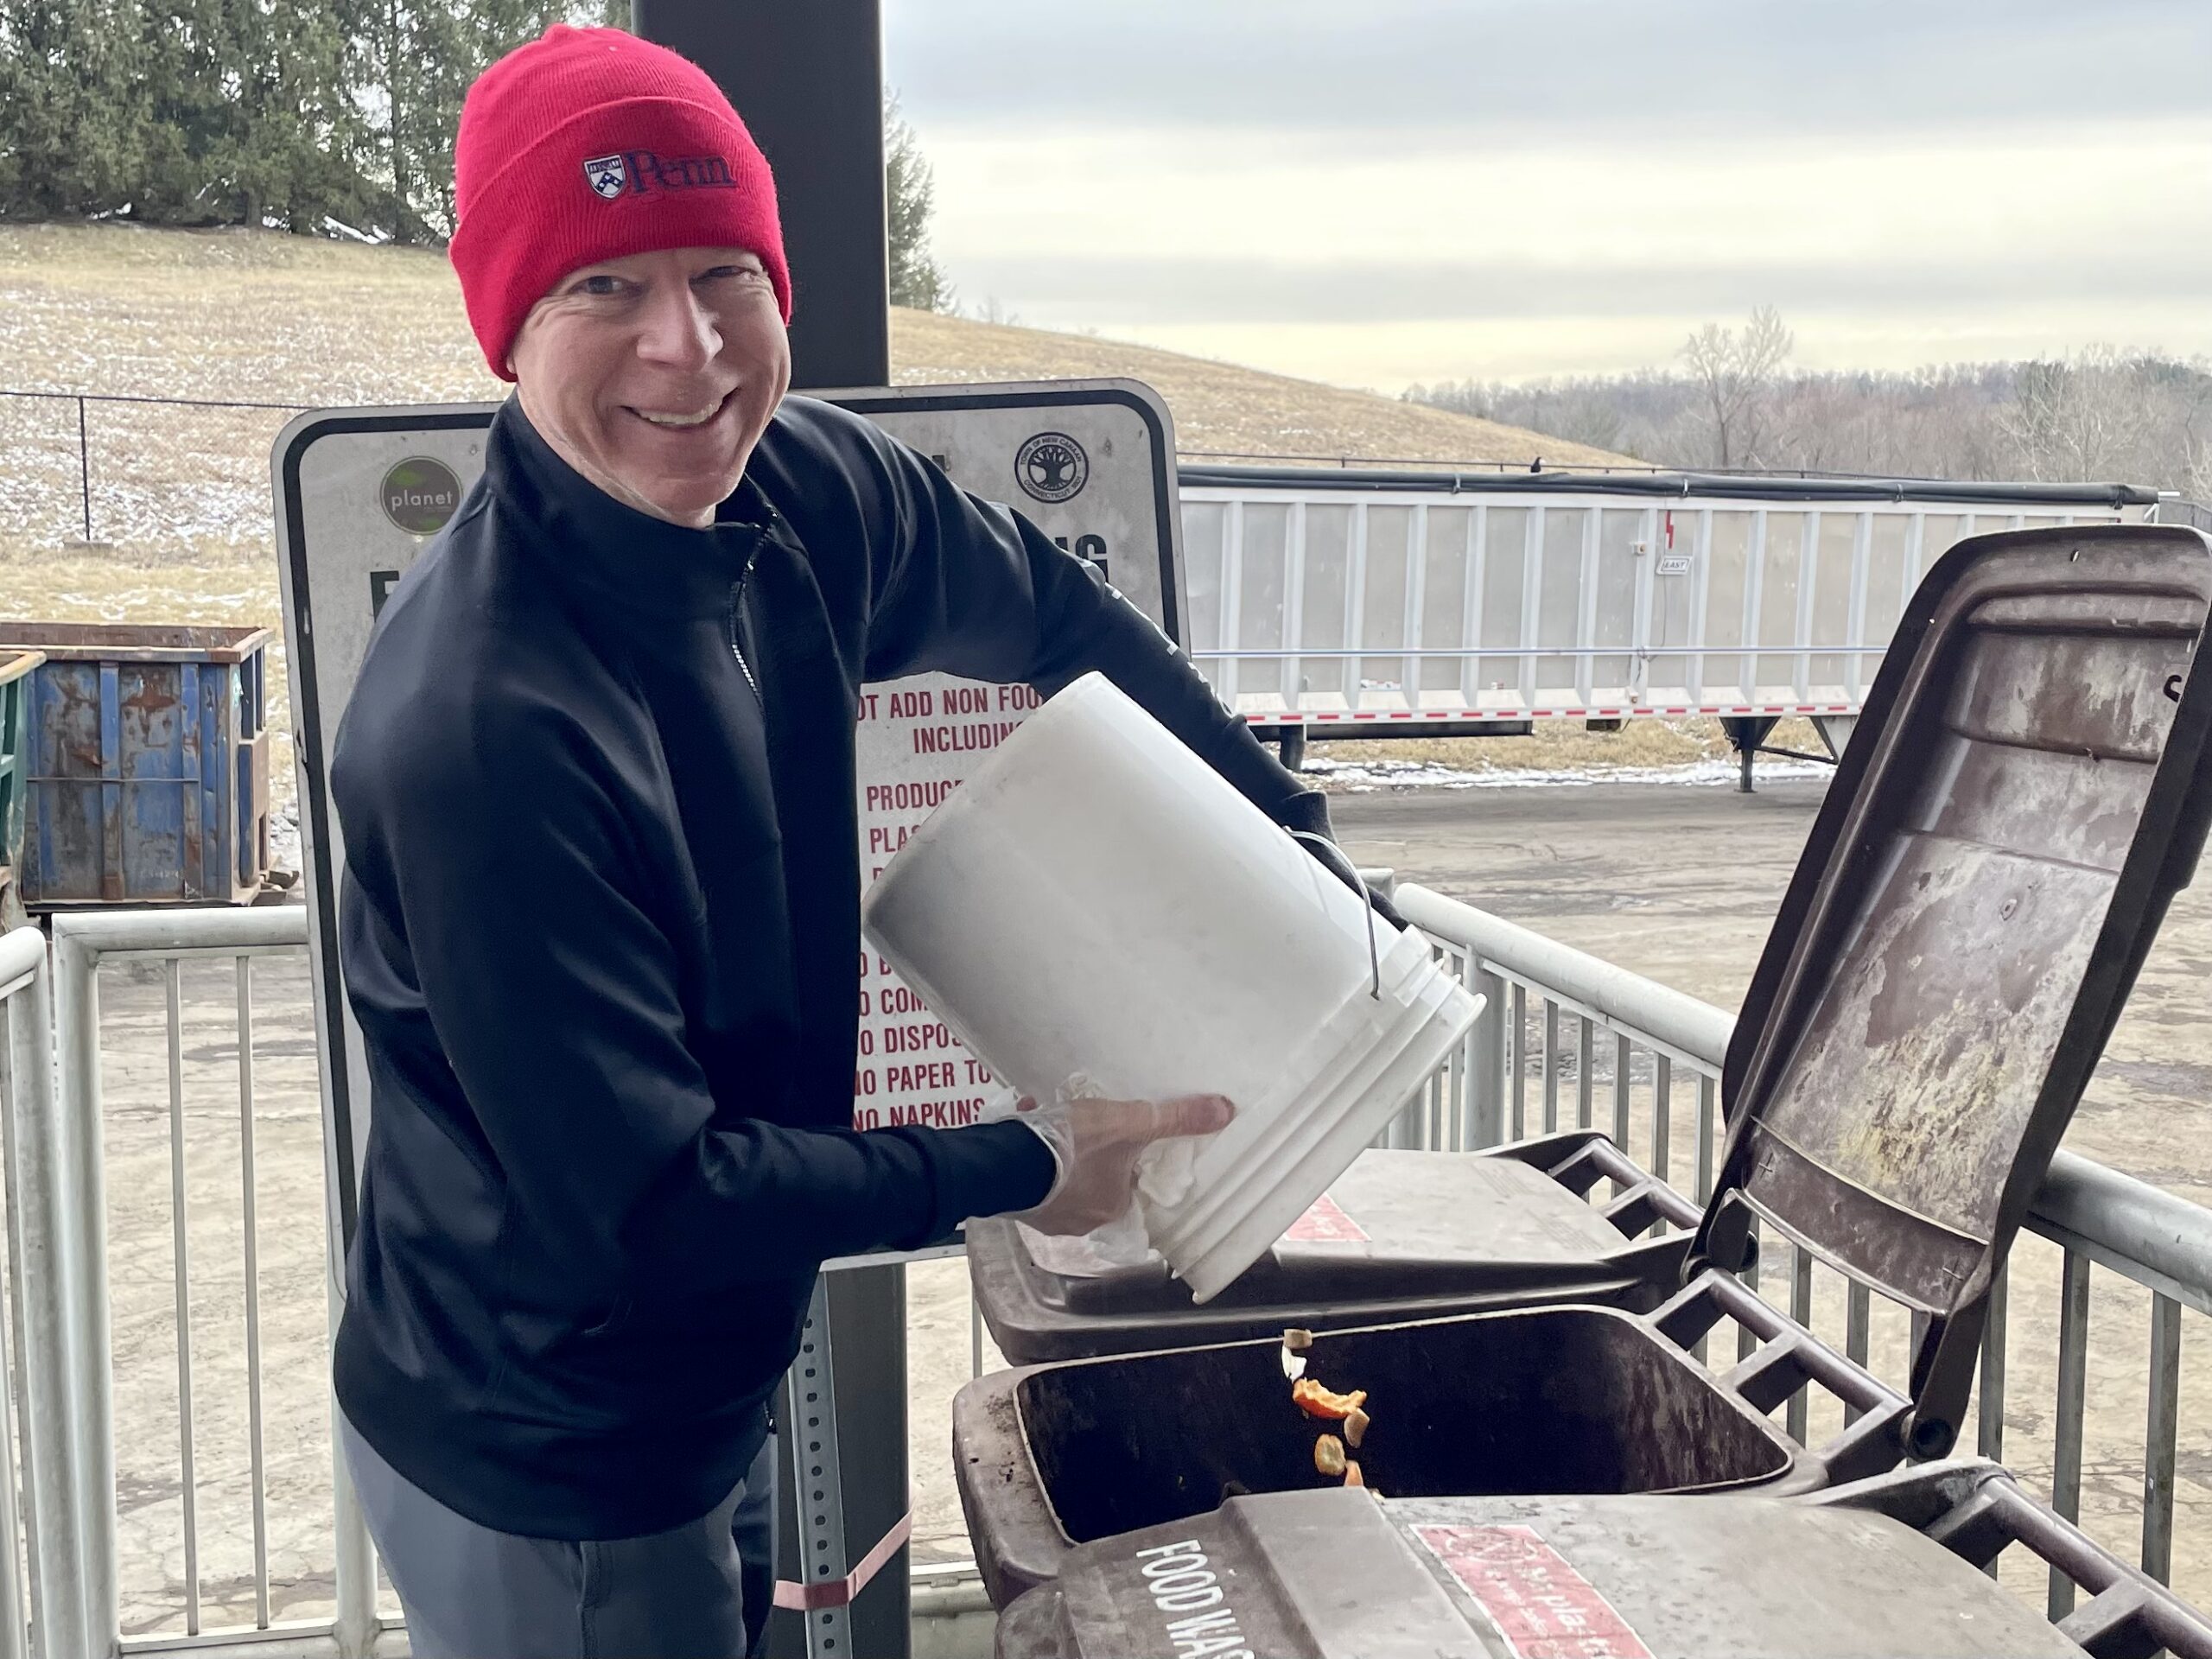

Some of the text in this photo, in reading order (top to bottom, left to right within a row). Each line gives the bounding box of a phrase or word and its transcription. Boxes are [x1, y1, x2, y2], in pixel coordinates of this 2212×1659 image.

[624, 150, 738, 196] Penn
[391, 489, 453, 512] planet
[858, 685, 1040, 721] OT ADD NON FOO
[913, 721, 1024, 753] INCLUDIN
[867, 779, 963, 811] PRODUC
[887, 1062, 955, 1093] PAPER
[852, 1109, 879, 1134] NO
[1136, 1539, 1224, 1611] FOOD
